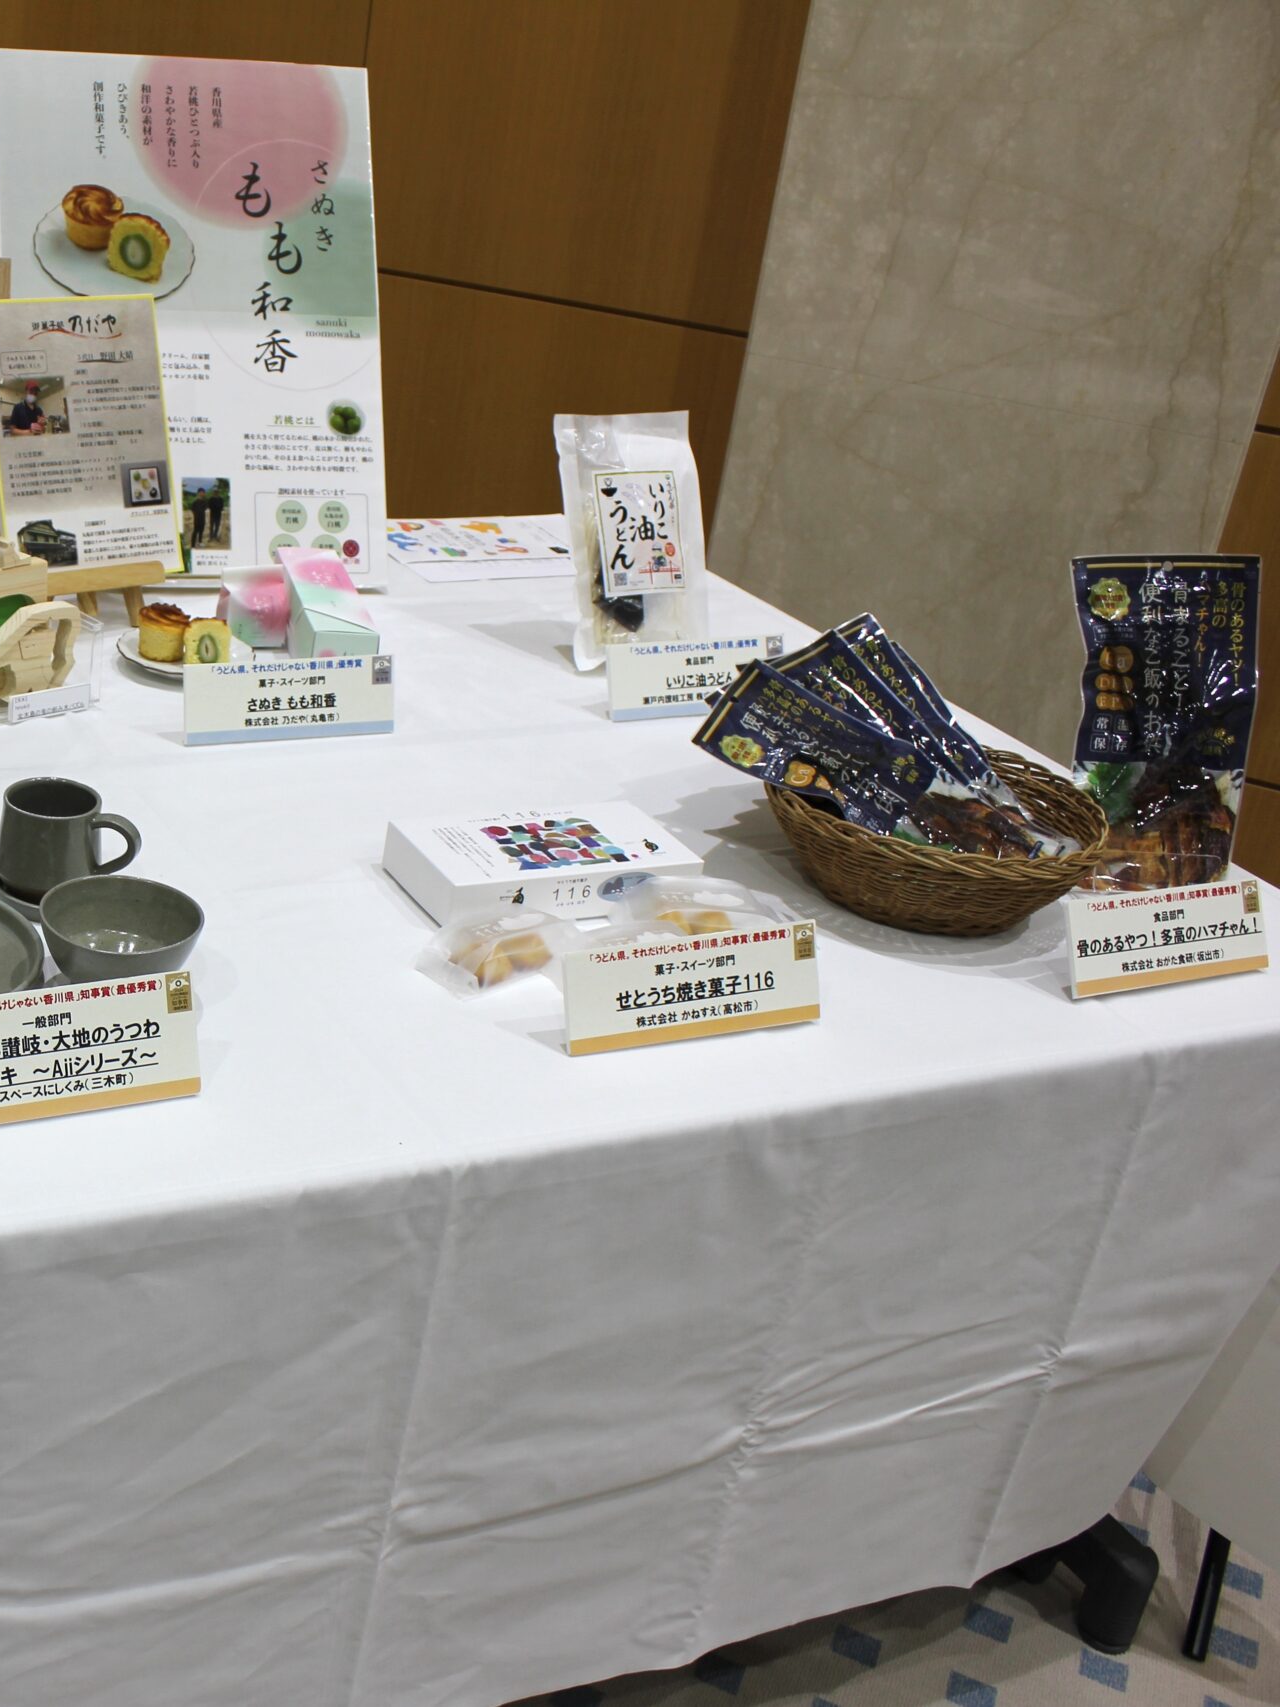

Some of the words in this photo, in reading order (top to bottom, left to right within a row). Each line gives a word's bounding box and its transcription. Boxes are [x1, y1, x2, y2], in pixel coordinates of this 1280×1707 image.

[92, 80, 107, 160] 創作和菓子です。
[141, 83, 153, 146] 和洋の素材が
[164, 84, 178, 168] さわやかな香りに
[310, 159, 336, 252] さぬき
[315, 318, 348, 328] sanuki
[305, 329, 361, 339] momowaka
[649, 482, 668, 539] いりこ
[629, 515, 655, 542] 油
[212, 659, 363, 674] 「うどん県。それだけじゃない香川県」優秀賞
[685, 656, 714, 665] 食品部門
[258, 676, 326, 688] 菓子・スイーツ部門
[247, 697, 282, 711] さぬき
[287, 693, 337, 709] もも和香
[244, 715, 278, 727] 株式会社
[553, 885, 591, 901] 116
[1153, 909, 1185, 923] 食品部門
[655, 955, 736, 976] 菓子・スイーツ部門
[1121, 959, 1154, 972] 株式会社
[616, 971, 775, 1010] せとうち焼き菓子116
[22, 1012, 72, 1029] 一般部門
[636, 1011, 678, 1028] 株式会社
